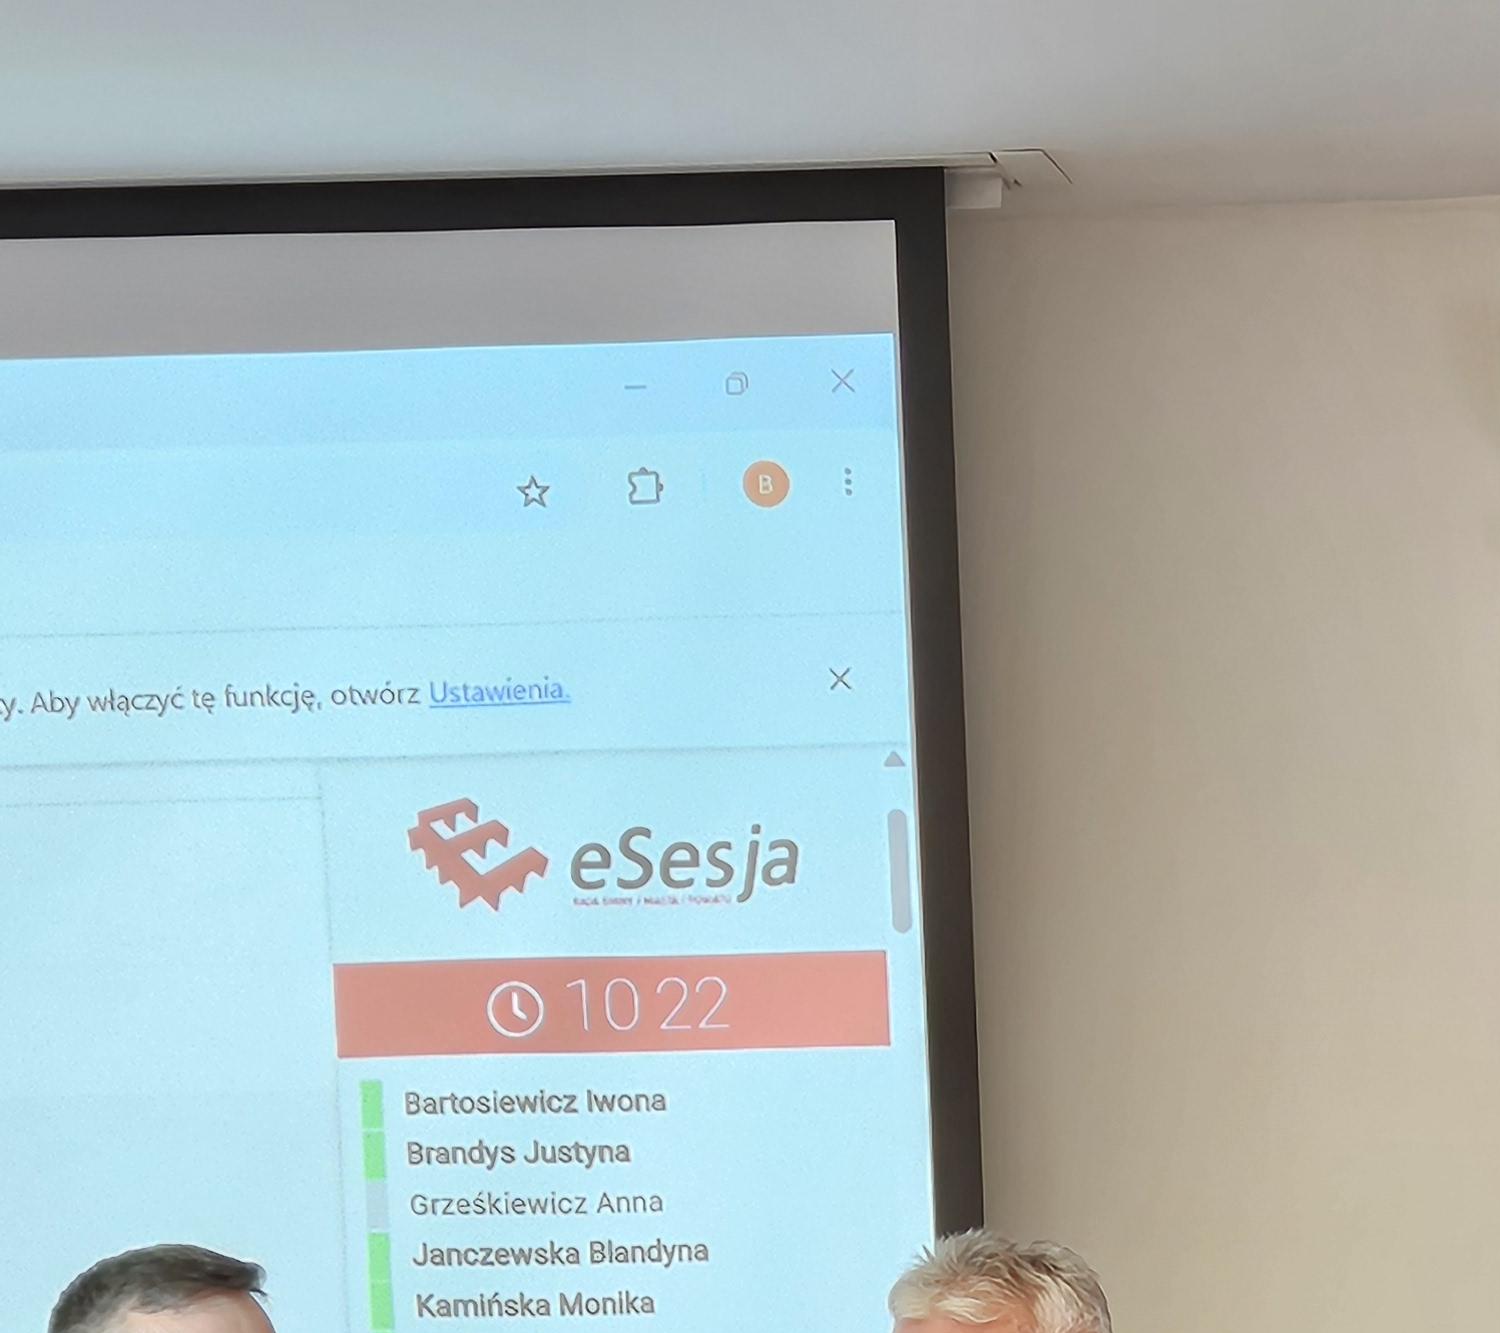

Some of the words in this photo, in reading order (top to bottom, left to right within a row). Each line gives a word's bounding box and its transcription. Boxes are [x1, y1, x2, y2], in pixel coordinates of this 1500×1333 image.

[31, 689, 79, 719] Aby
[87, 686, 184, 717] włączyć
[192, 688, 215, 714] tę
[224, 682, 323, 714] funkcję,
[331, 680, 420, 706] otwórz
[429, 675, 571, 708] Ustawienia.
[570, 823, 799, 904] eSesja
[404, 1089, 579, 1115] Bartosiewicz
[586, 1088, 667, 1113] Iwona
[406, 1140, 516, 1170] Brandys
[524, 1140, 632, 1169] Justyna
[410, 1190, 588, 1216] Grześkiewicz
[596, 1191, 664, 1214] Anna
[412, 1241, 581, 1267] Janczewska
[589, 1238, 710, 1268] Blandyna
[416, 1291, 551, 1318] Kamińska
[559, 1290, 656, 1316] Monika
